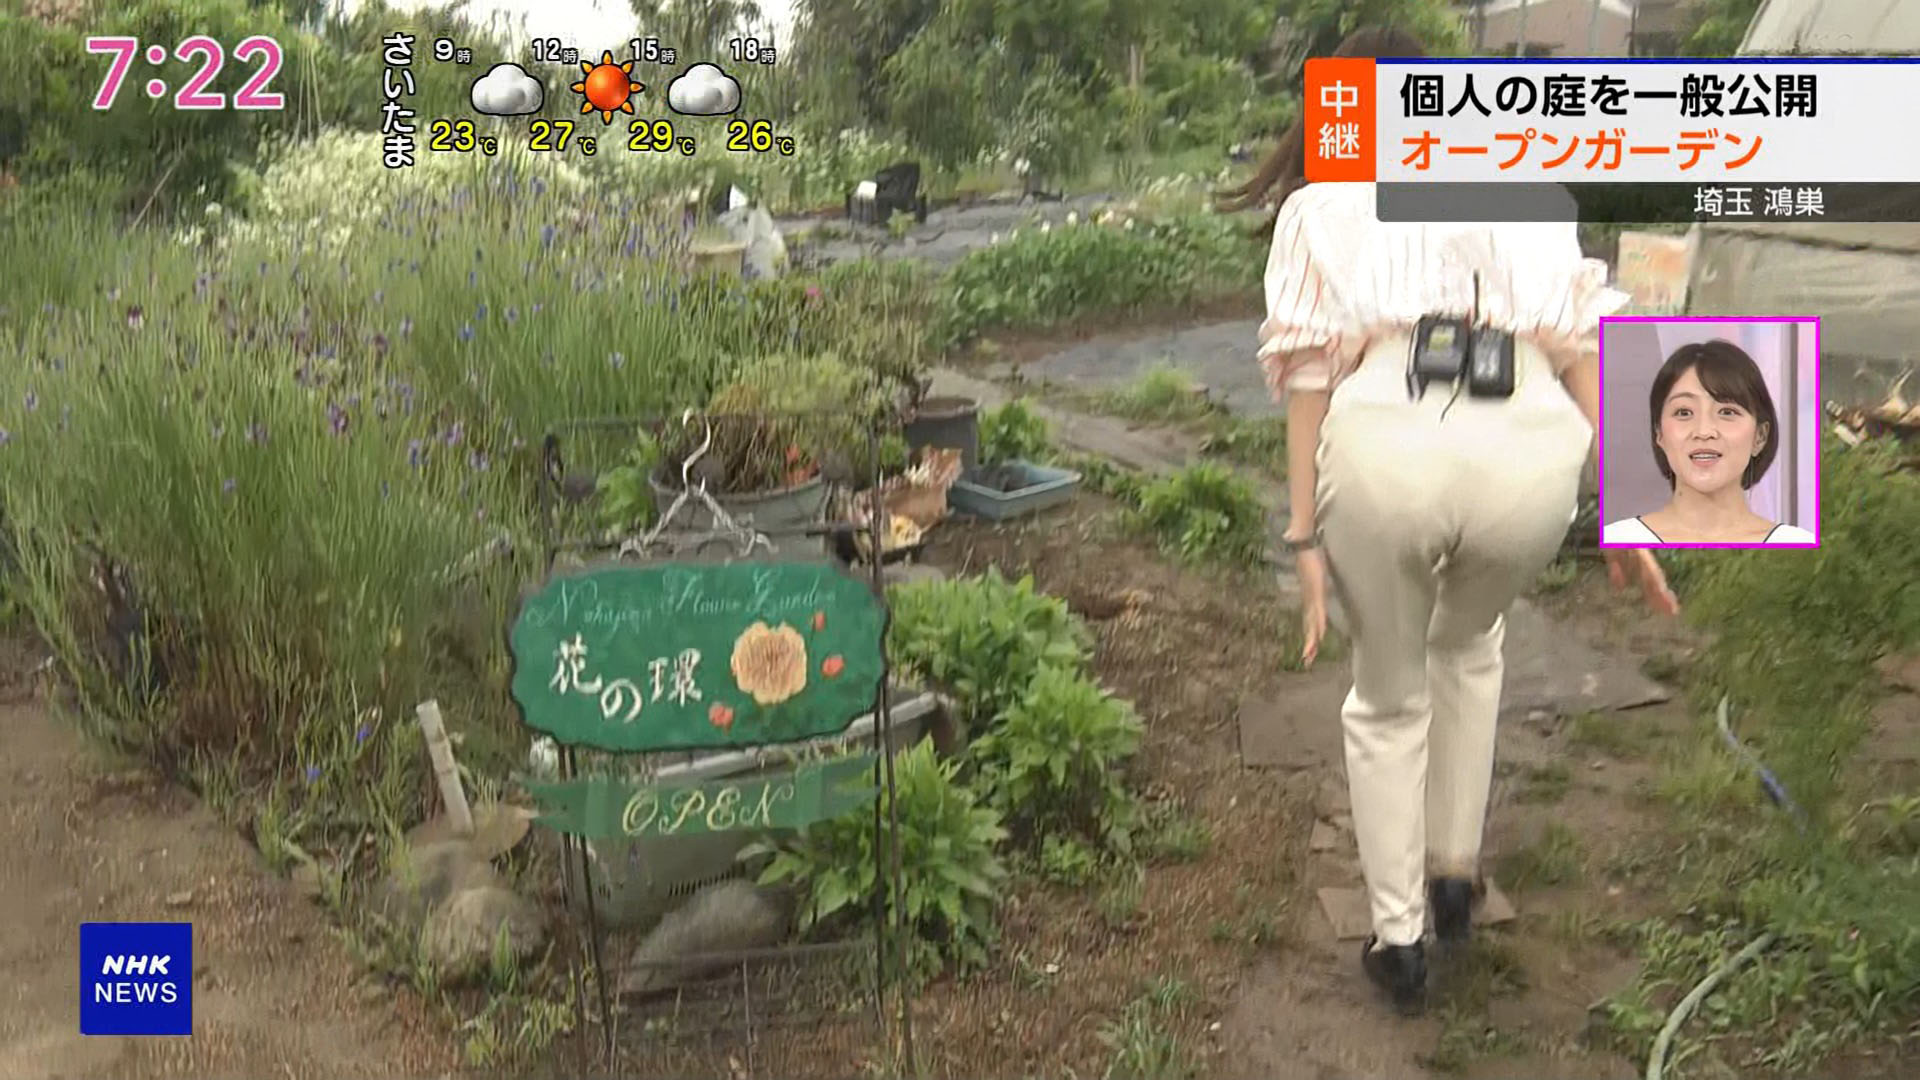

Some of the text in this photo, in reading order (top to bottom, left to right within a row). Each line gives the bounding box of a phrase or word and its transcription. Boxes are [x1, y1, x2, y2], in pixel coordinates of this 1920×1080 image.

[549, 632, 704, 724] 花の環
[622, 782, 795, 837] OPEN
